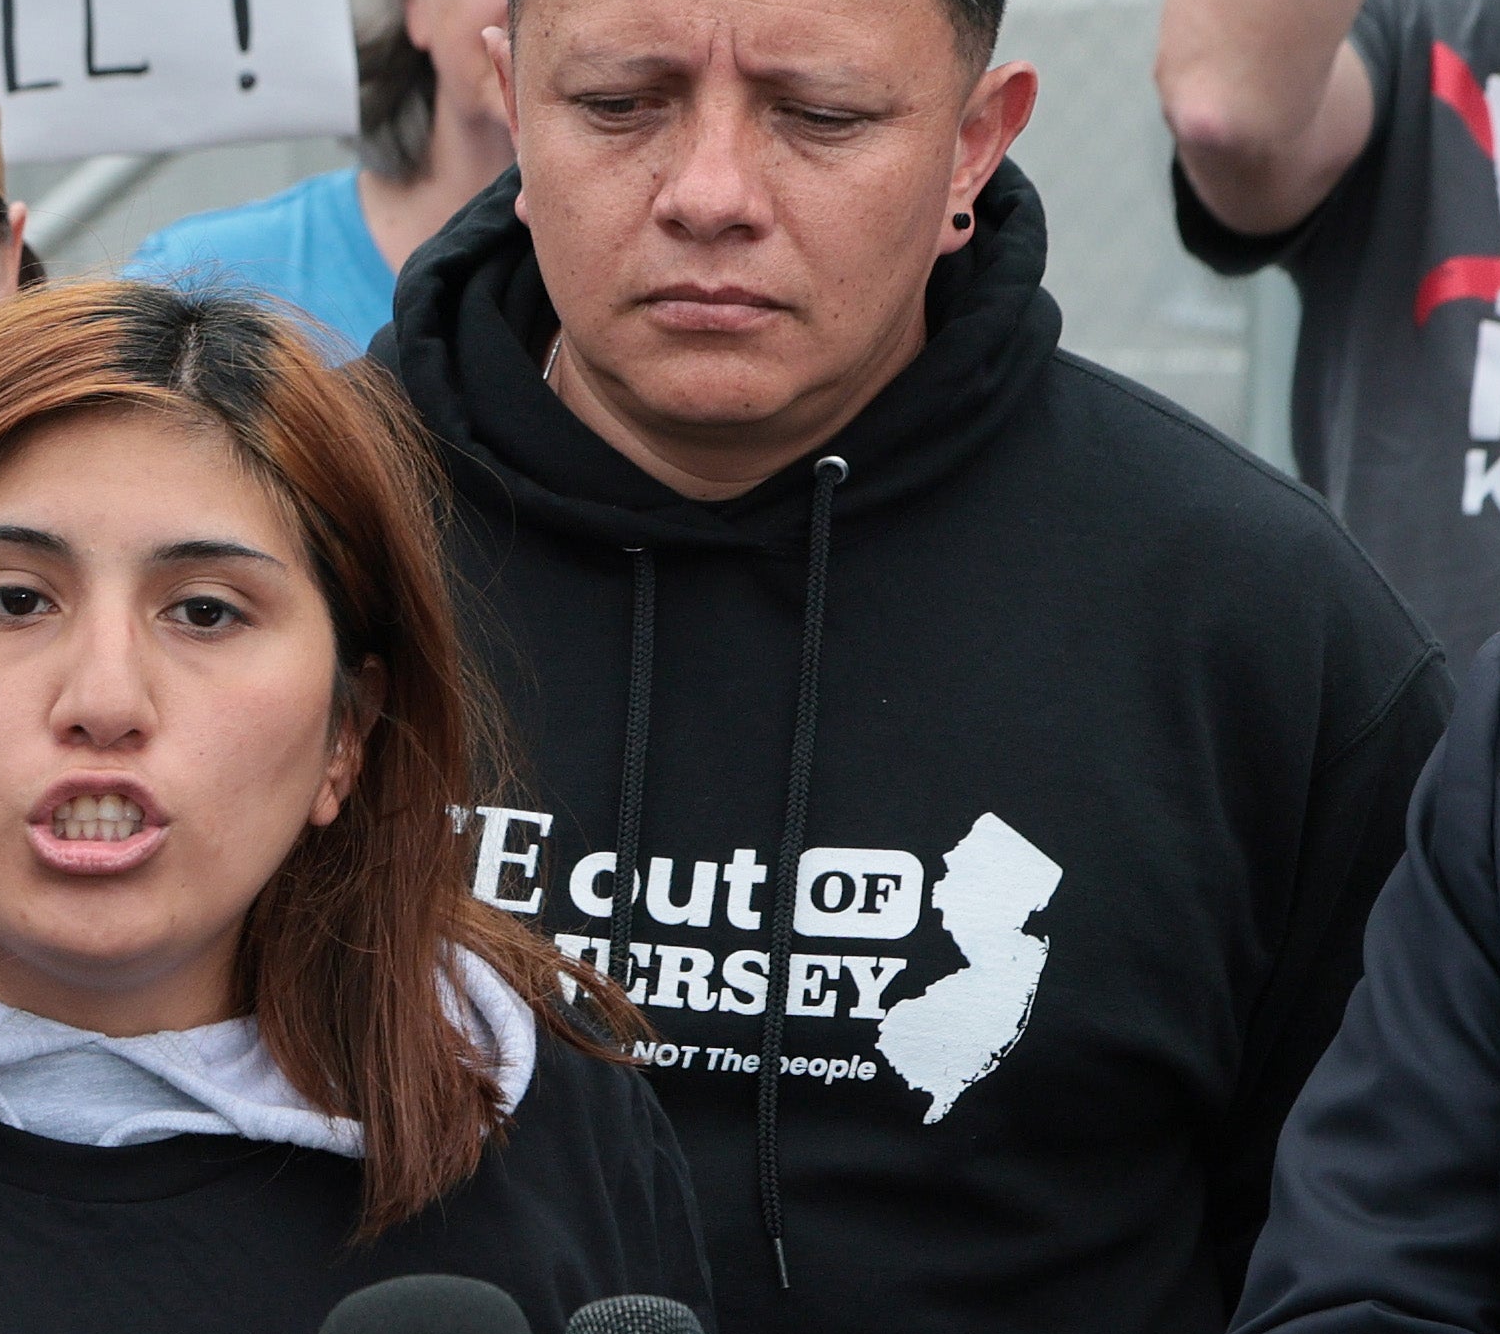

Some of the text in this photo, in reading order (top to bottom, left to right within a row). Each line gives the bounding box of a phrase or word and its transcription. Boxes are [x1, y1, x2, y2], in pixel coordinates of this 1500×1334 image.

[569, 848, 768, 931] out
[810, 871, 903, 917] OF
[631, 1039, 700, 1070] NOT
[706, 1047, 761, 1074] The
